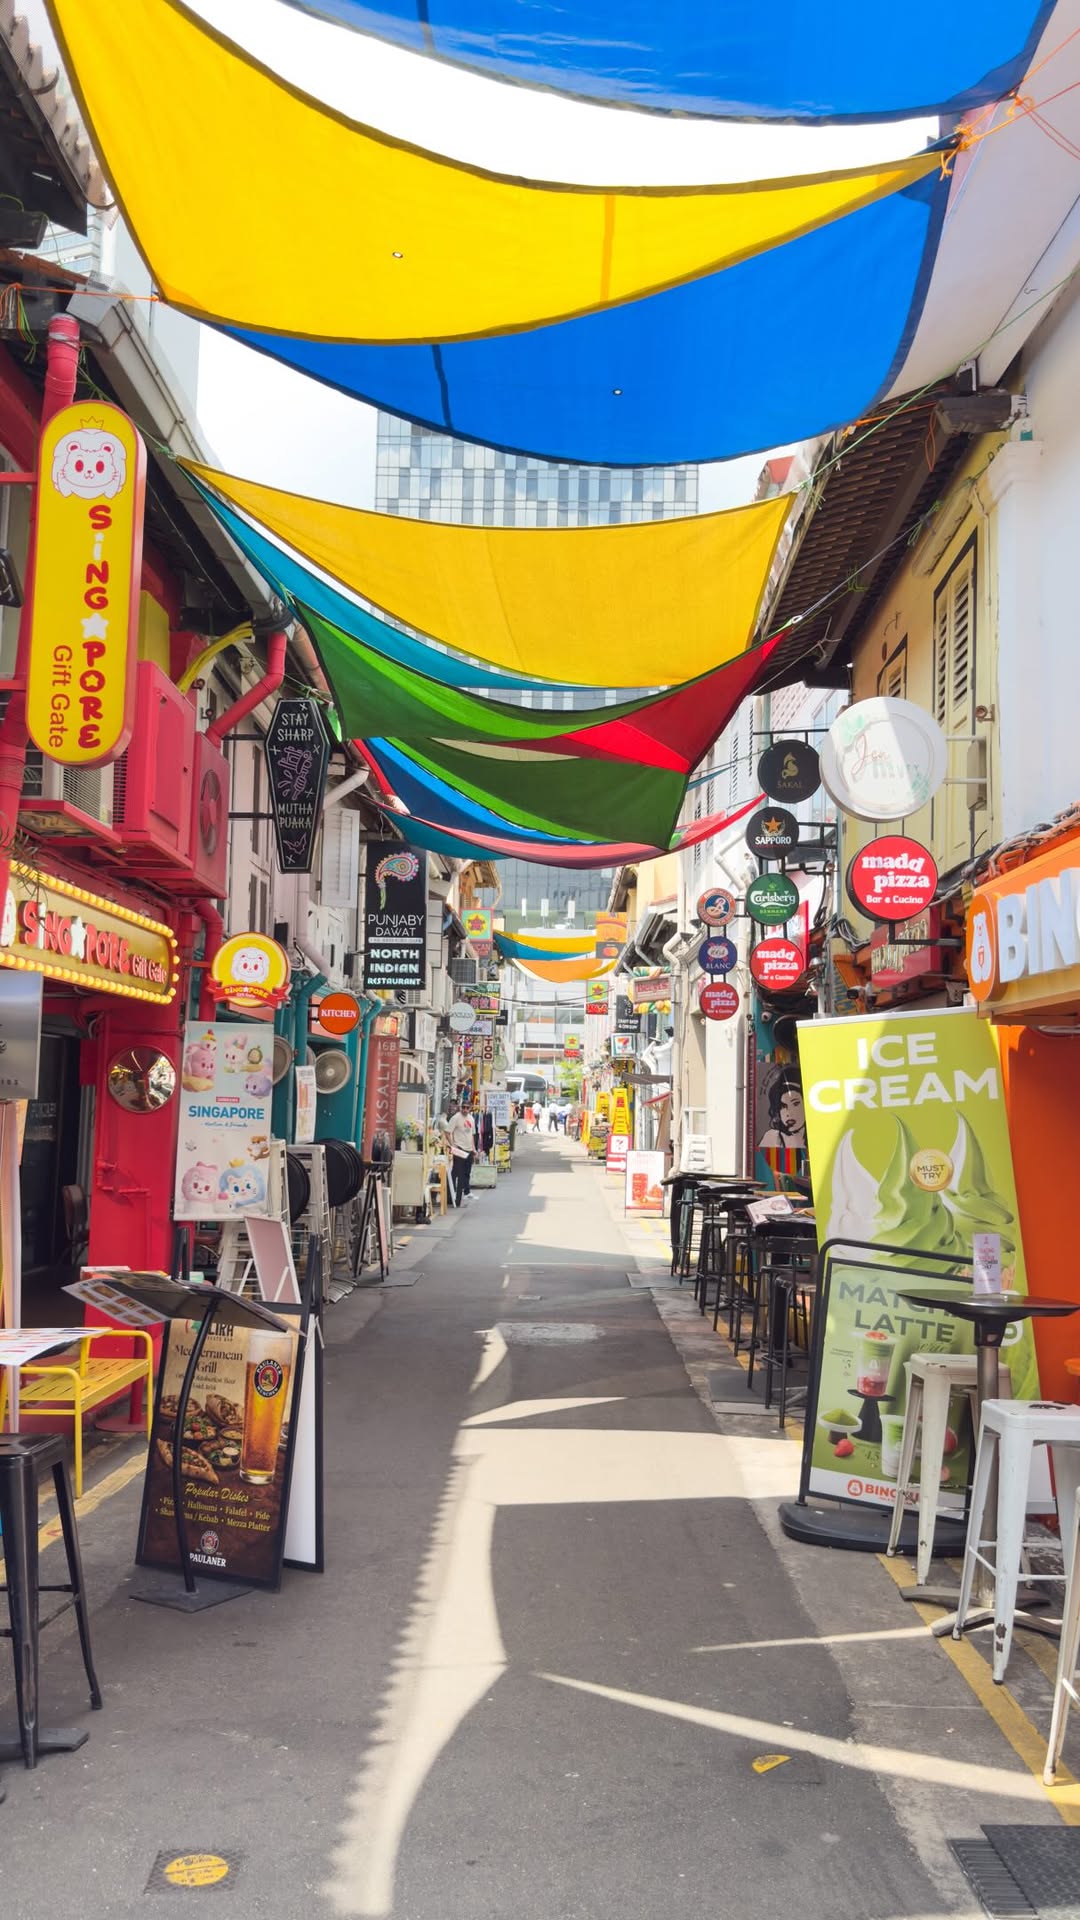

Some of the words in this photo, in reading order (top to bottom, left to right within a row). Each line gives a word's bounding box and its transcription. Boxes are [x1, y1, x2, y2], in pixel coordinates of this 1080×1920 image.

[52, 645, 73, 687] Gift
[49, 693, 71, 748] Gate
[281, 713, 309, 726] STAY
[278, 728, 314, 742] SHARP
[278, 803, 313, 815] MUTHA
[755, 836, 791, 845] SAPPORO
[873, 871, 931, 893] pizza
[750, 889, 796, 908] Carlsberg
[866, 894, 882, 904] Bar
[892, 895, 924, 904] Cucina
[368, 914, 425, 928] PUNJABY
[997, 867, 1080, 983] BIN
[375, 927, 416, 937] DAWAT
[370, 949, 420, 959] NORTH
[370, 963, 420, 974] INDIAN
[763, 961, 799, 974] pizza
[367, 977, 421, 985] RESTAURANT
[711, 999, 736, 1009] pizza
[321, 1009, 356, 1018] KITCHEN
[857, 1032, 938, 1071] ICE
[808, 1067, 999, 1113] CREAM
[188, 1105, 265, 1120] SINGAPORE
[916, 1164, 945, 1173] MUST
[922, 1172, 942, 1180] TRY
[854, 1309, 956, 1343] LATTE
[197, 1361, 217, 1374] Grill
[185, 1482, 220, 1498] Popular
[221, 1488, 250, 1503] Dishes
[187, 1500, 218, 1513] Halloumi
[225, 1507, 248, 1517] Falafel
[255, 1510, 271, 1521] Pide
[198, 1514, 219, 1524] Kebab
[226, 1518, 248, 1529] Mezza
[248, 1520, 271, 1532] Platter
[189, 1552, 227, 1568] PAULANER
